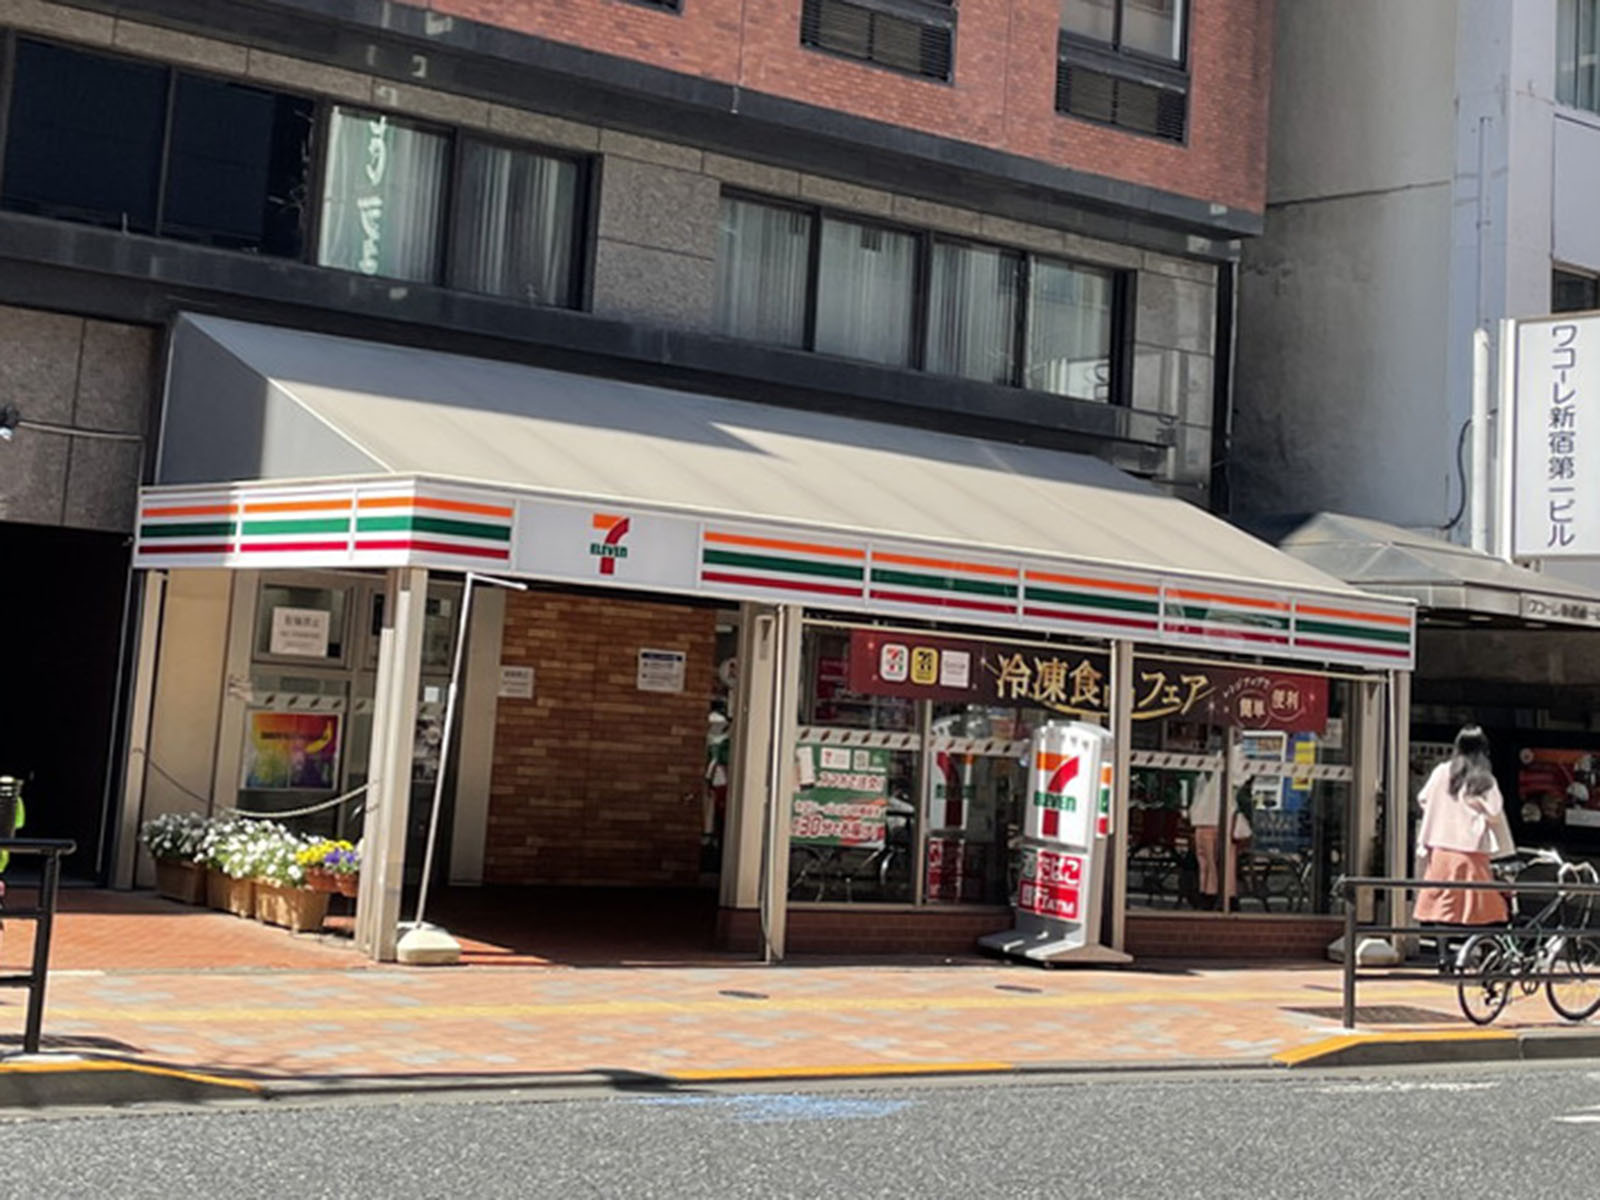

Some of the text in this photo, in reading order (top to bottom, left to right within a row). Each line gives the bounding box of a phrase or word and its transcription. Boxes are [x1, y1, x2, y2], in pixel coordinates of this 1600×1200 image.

[1547, 324, 1577, 548] ワコーレ新宿第一ビル
[593, 514, 630, 575] 7
[996, 652, 1210, 715] 冷凍食フェア
[1036, 752, 1080, 837] 7
